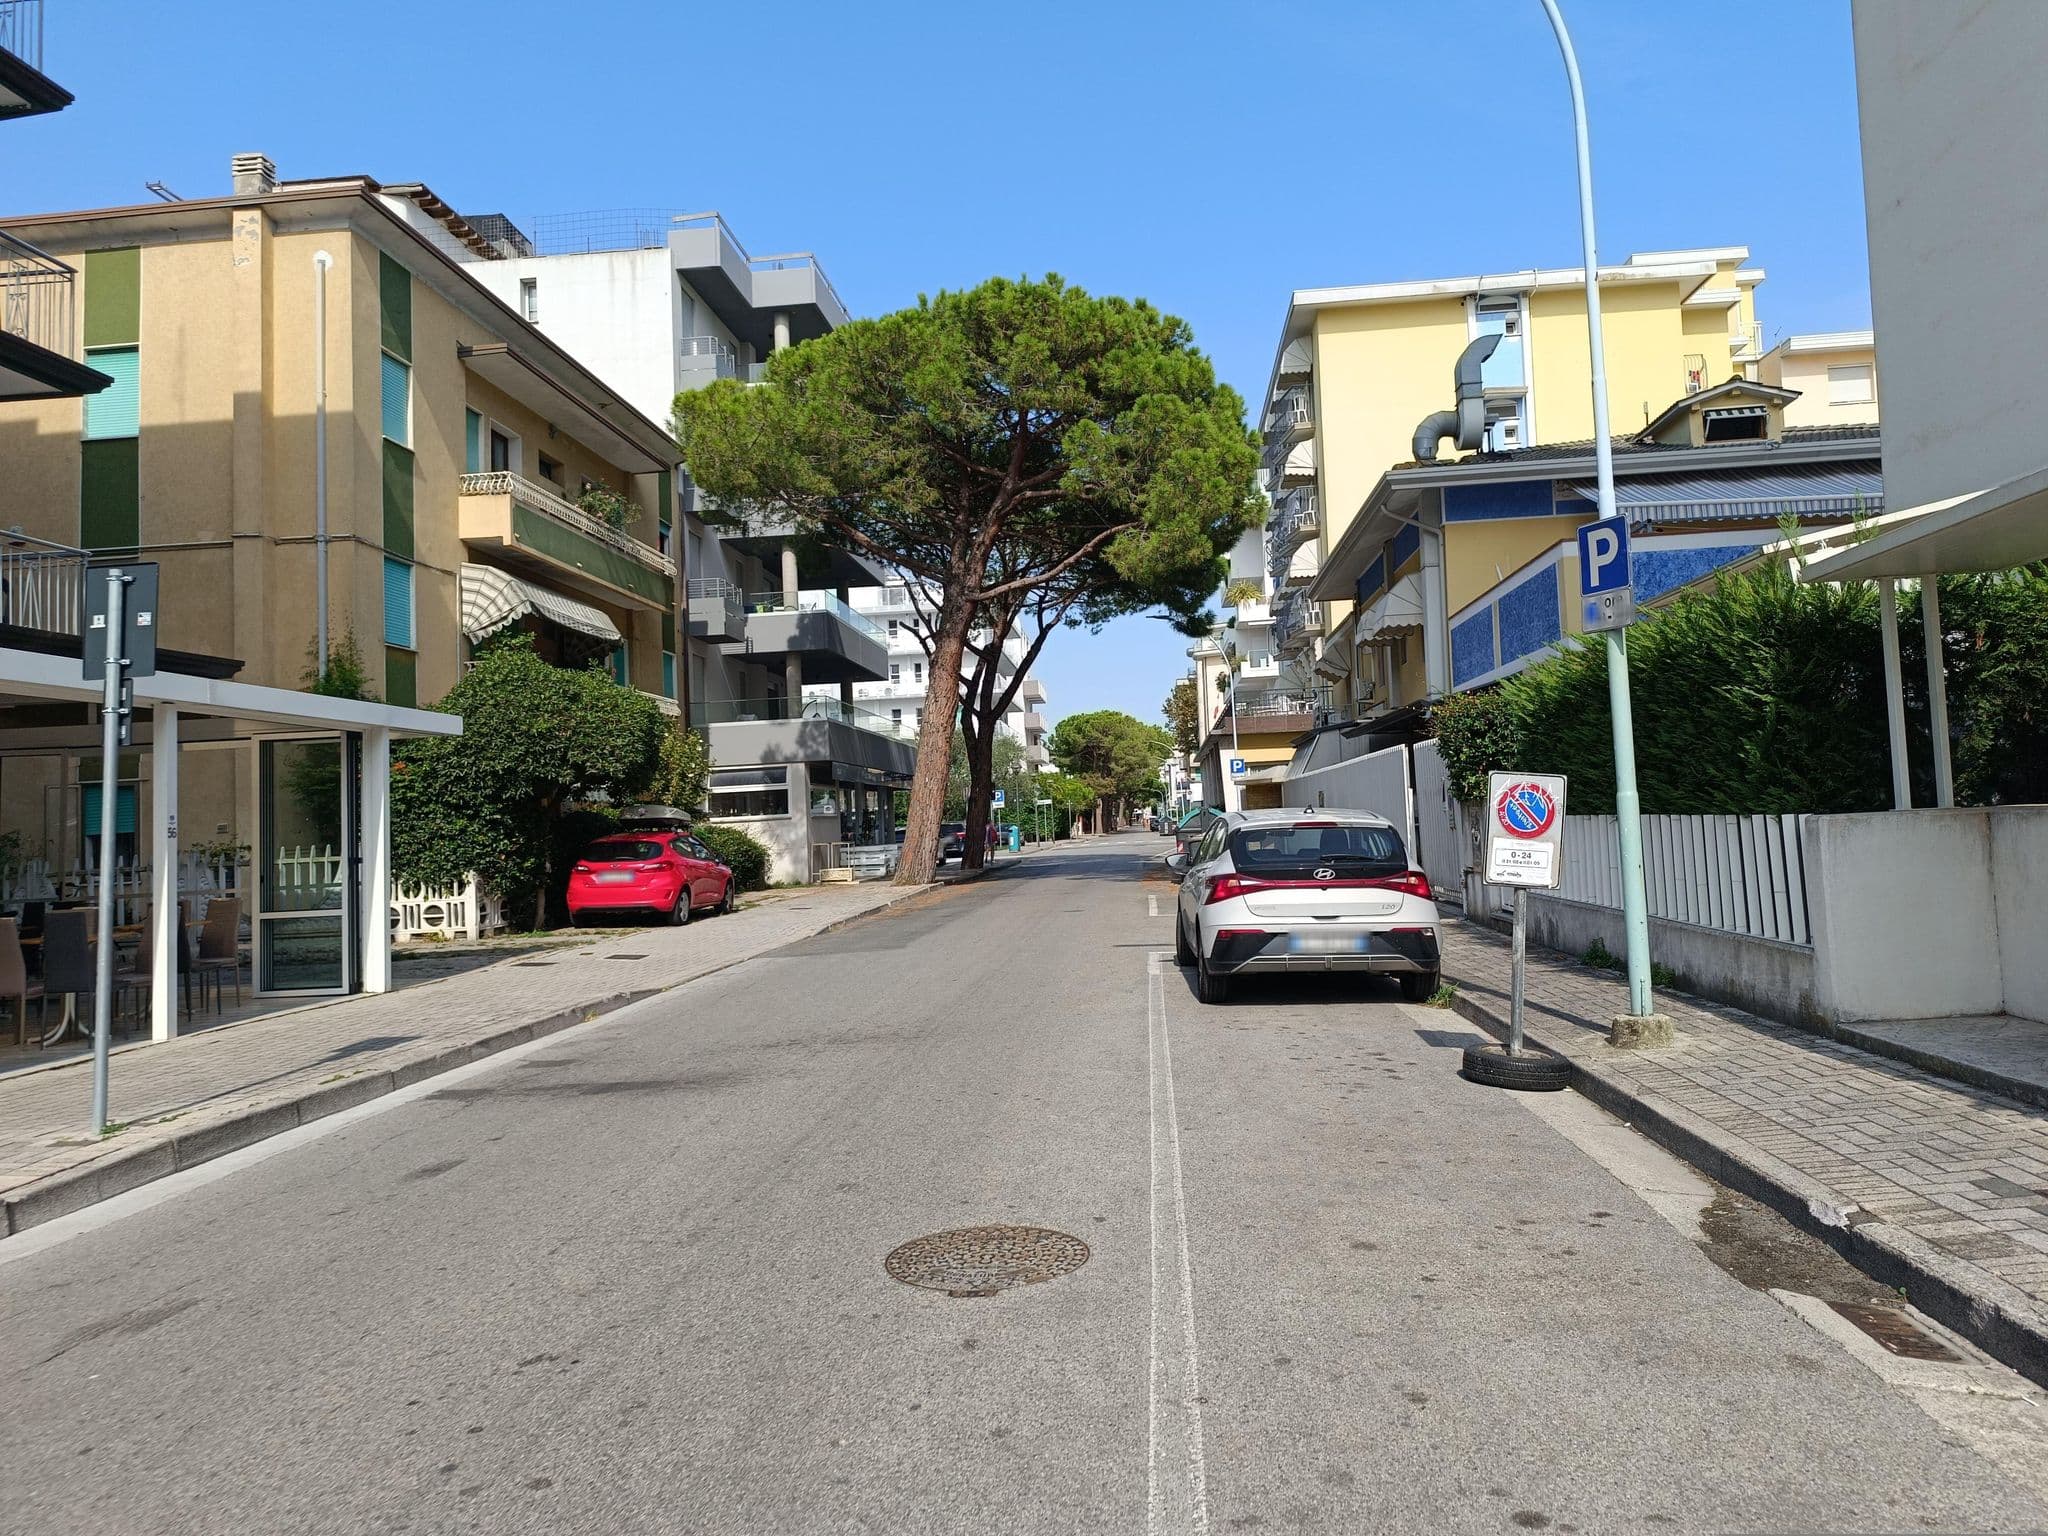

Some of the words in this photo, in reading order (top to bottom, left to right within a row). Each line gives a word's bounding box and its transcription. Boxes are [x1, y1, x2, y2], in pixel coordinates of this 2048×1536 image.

[1587, 527, 1619, 588] P
[1232, 760, 1243, 771] P
[995, 791, 1002, 800] P
